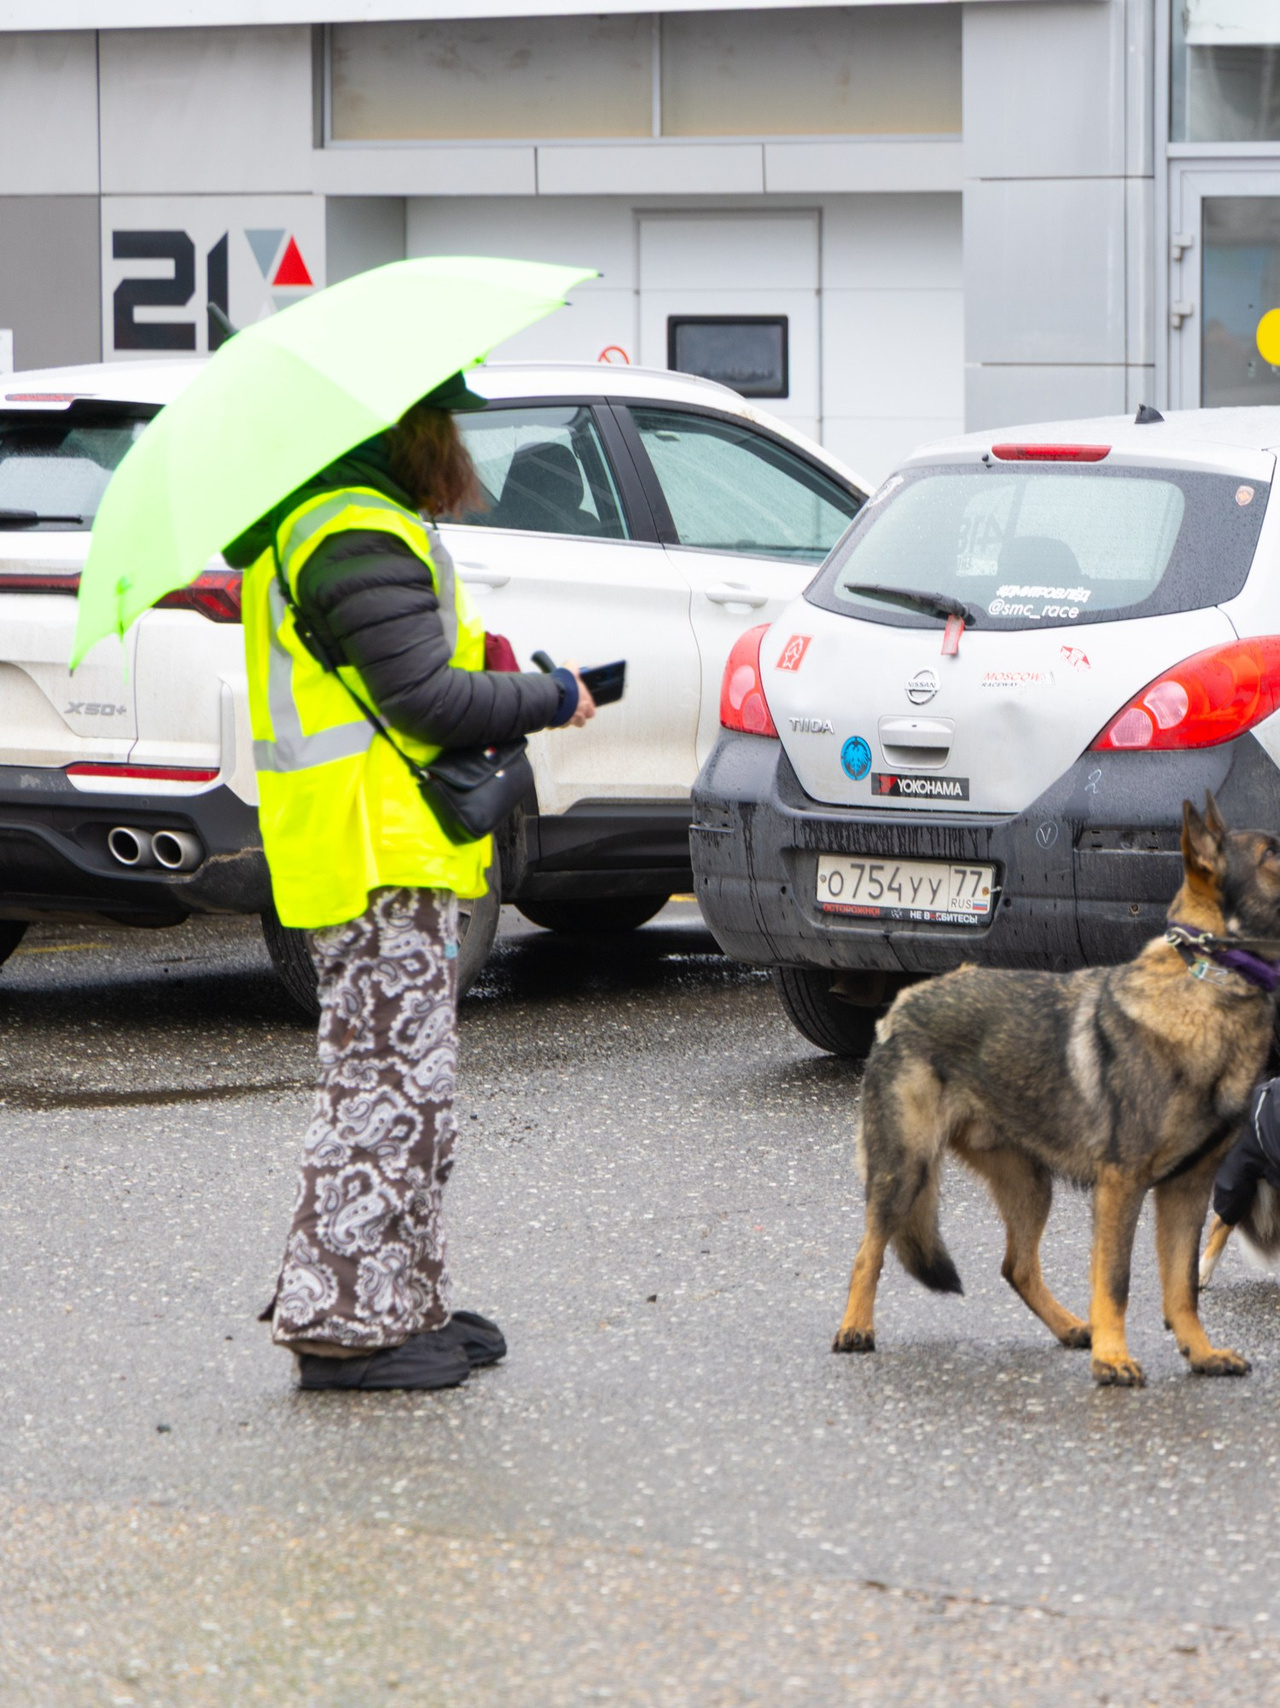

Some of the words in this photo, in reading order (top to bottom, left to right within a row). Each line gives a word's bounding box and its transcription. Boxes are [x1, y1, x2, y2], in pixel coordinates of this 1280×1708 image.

[988, 598, 1080, 619] @smc_race
[984, 671, 1042, 682] MOSCOW
[908, 681, 936, 689] NISSAN
[64, 701, 127, 716] X50+
[788, 717, 835, 735] TIIDA
[897, 778, 963, 796] YOKOHAMA
[954, 869, 983, 898] 77
[951, 898, 972, 909] RUS
[910, 910, 922, 920] НЕ
